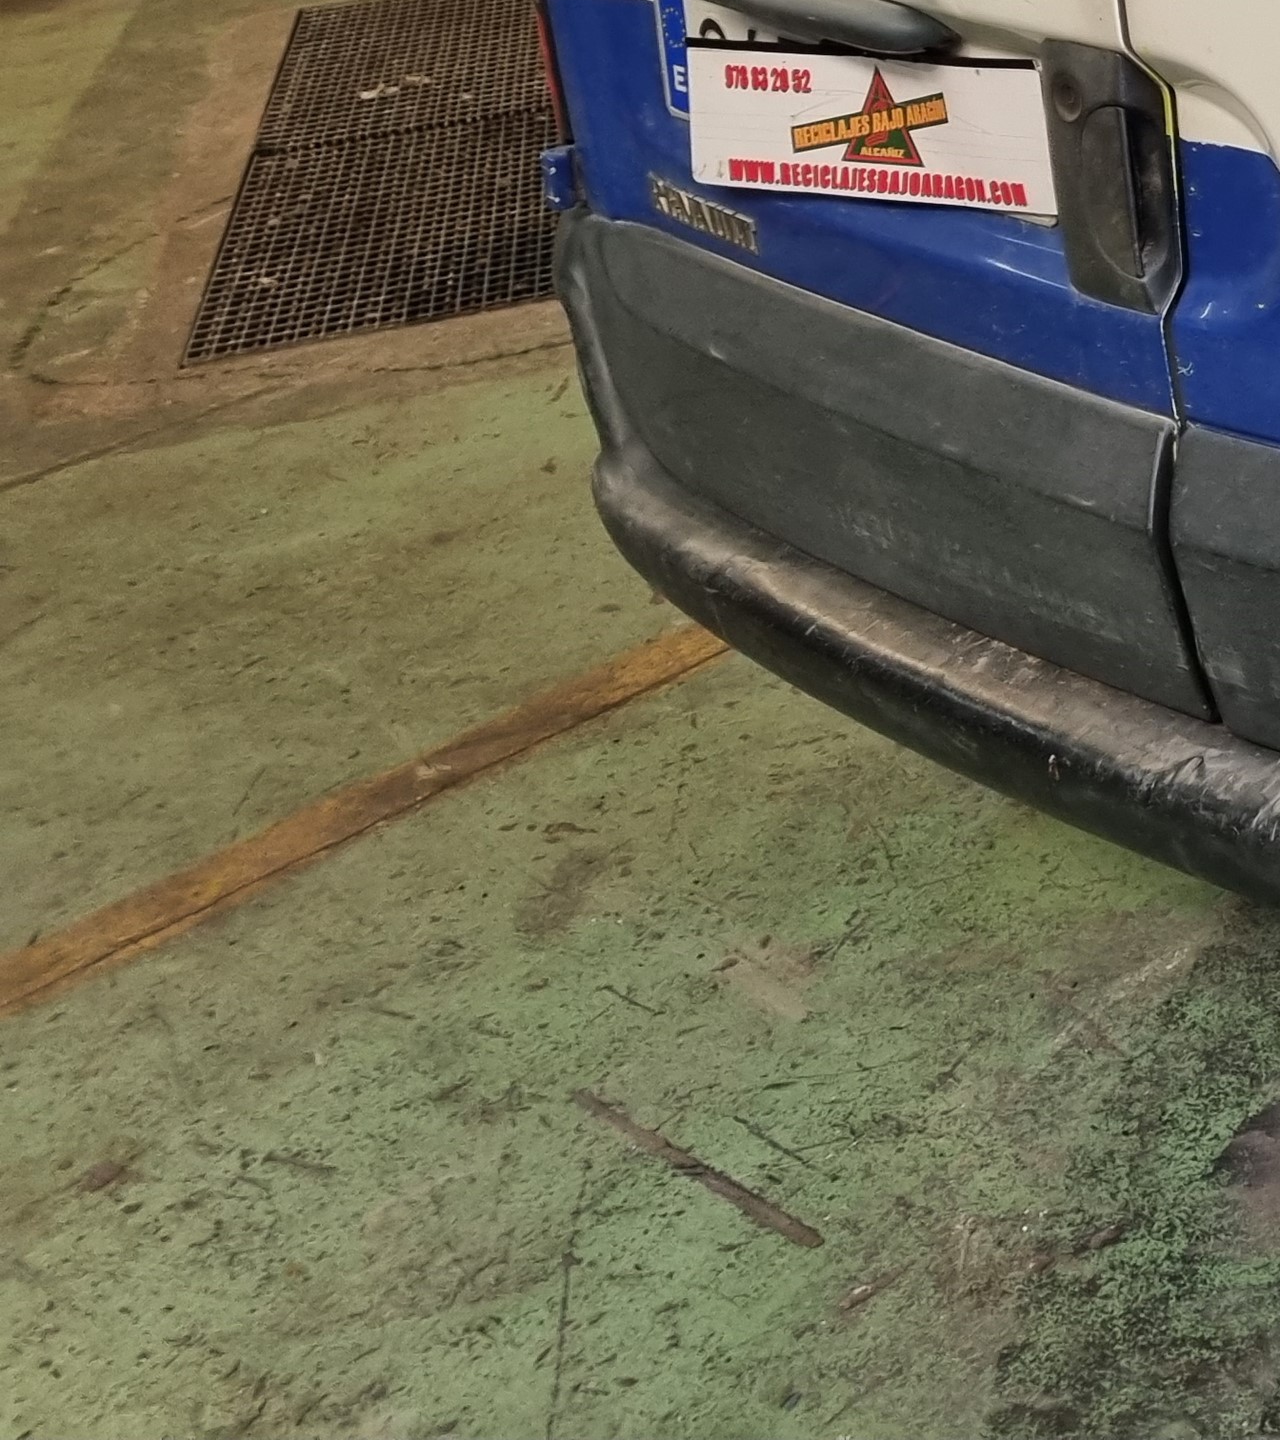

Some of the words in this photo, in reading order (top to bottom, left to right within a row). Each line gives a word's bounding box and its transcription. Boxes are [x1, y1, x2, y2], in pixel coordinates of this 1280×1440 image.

[672, 64, 688, 93] E
[792, 69, 812, 93] 52
[794, 115, 870, 149] RECICLAJES
[872, 107, 904, 133] BAJO
[729, 159, 1027, 206] WWW.RECICLAJESBAJOARAGON.COM
